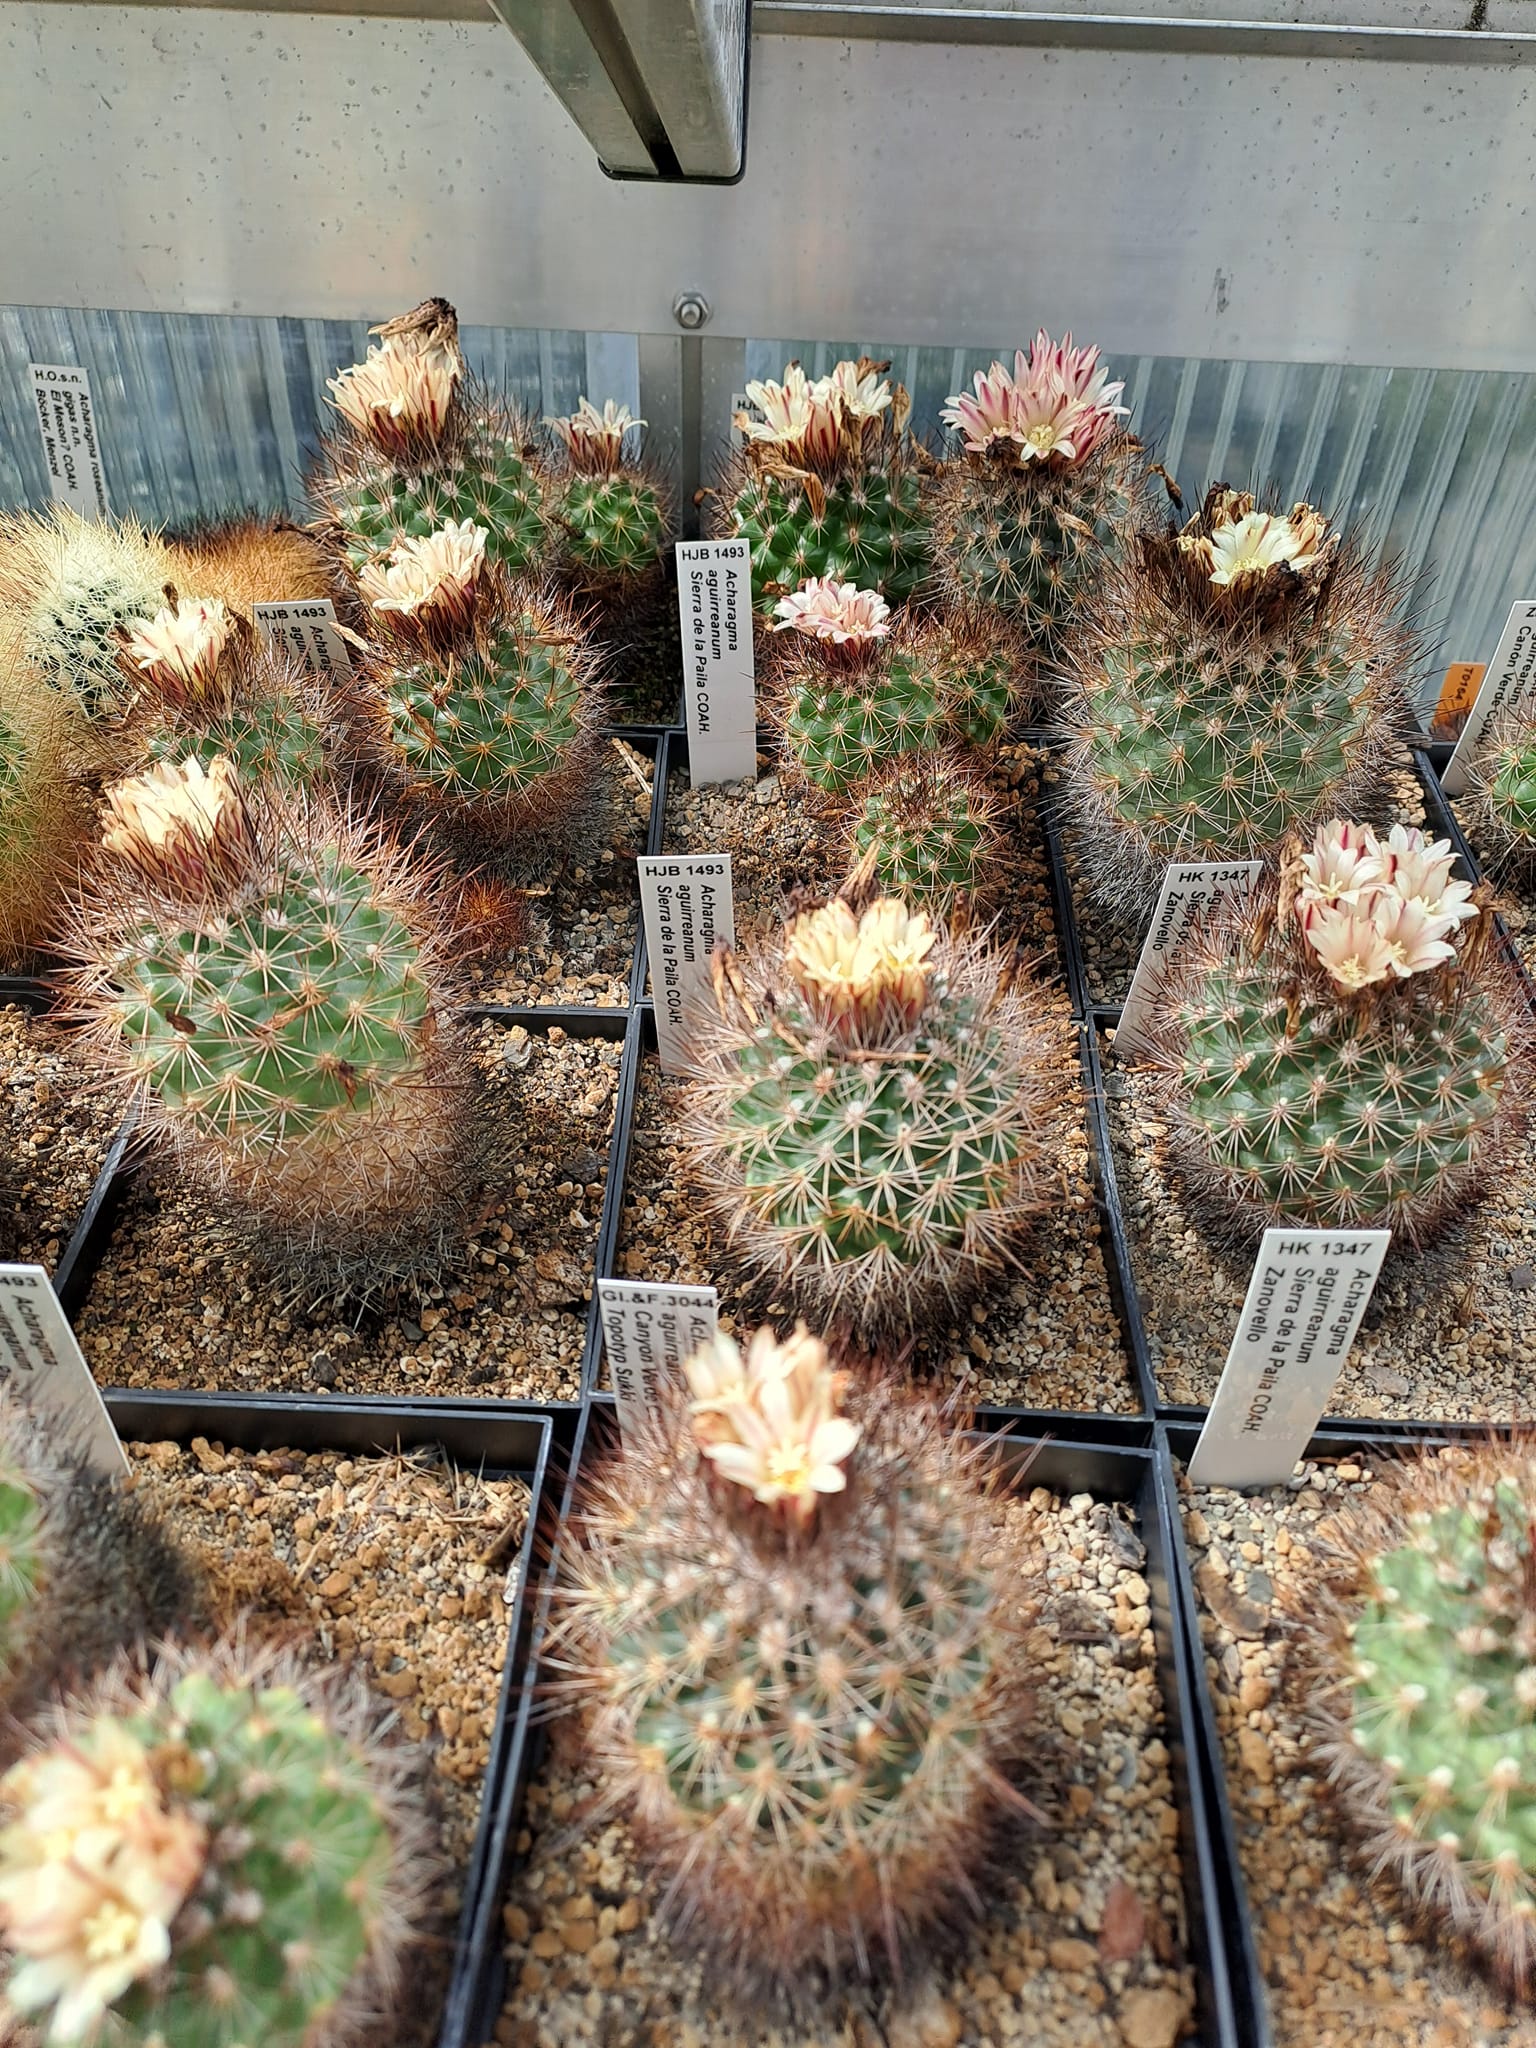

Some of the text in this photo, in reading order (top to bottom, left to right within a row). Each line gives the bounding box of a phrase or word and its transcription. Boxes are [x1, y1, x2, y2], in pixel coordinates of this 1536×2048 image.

[34, 369, 82, 384] H.O.s.n.
[50, 390, 62, 402] El
[62, 390, 81, 448] gigas n.n.
[78, 392, 97, 459] Acharagma
[45, 436, 61, 477] Menzel
[682, 547, 745, 560] HJB 1493
[257, 607, 327, 620] HJB 1493
[705, 569, 721, 660] aguirreanum
[724, 569, 739, 651] Acharagma
[309, 625, 334, 680] Acharag
[691, 571, 711, 735] Sierra de la Paila COAH.
[1506, 626, 1532, 667] Canón
[1491, 672, 1515, 706] Verde
[646, 864, 724, 877] HJB 1493
[1178, 869, 1250, 883] HK 1347
[676, 884, 696, 963] aguirreanum
[1152, 891, 1184, 951] Zanovello
[657, 884, 683, 1026] Sierra de la Paila COAH.
[1278, 1241, 1373, 1256] HK 1347
[1246, 1266, 1286, 1343] Zanovello
[1296, 1267, 1340, 1364] aguirreanum
[1326, 1268, 1372, 1356] Acharagma
[605, 1309, 637, 1403] Topotyp Sukki
[633, 1310, 653, 1363] Canyon
[1241, 1267, 1315, 1434] Sierra de la Paila COAH.
